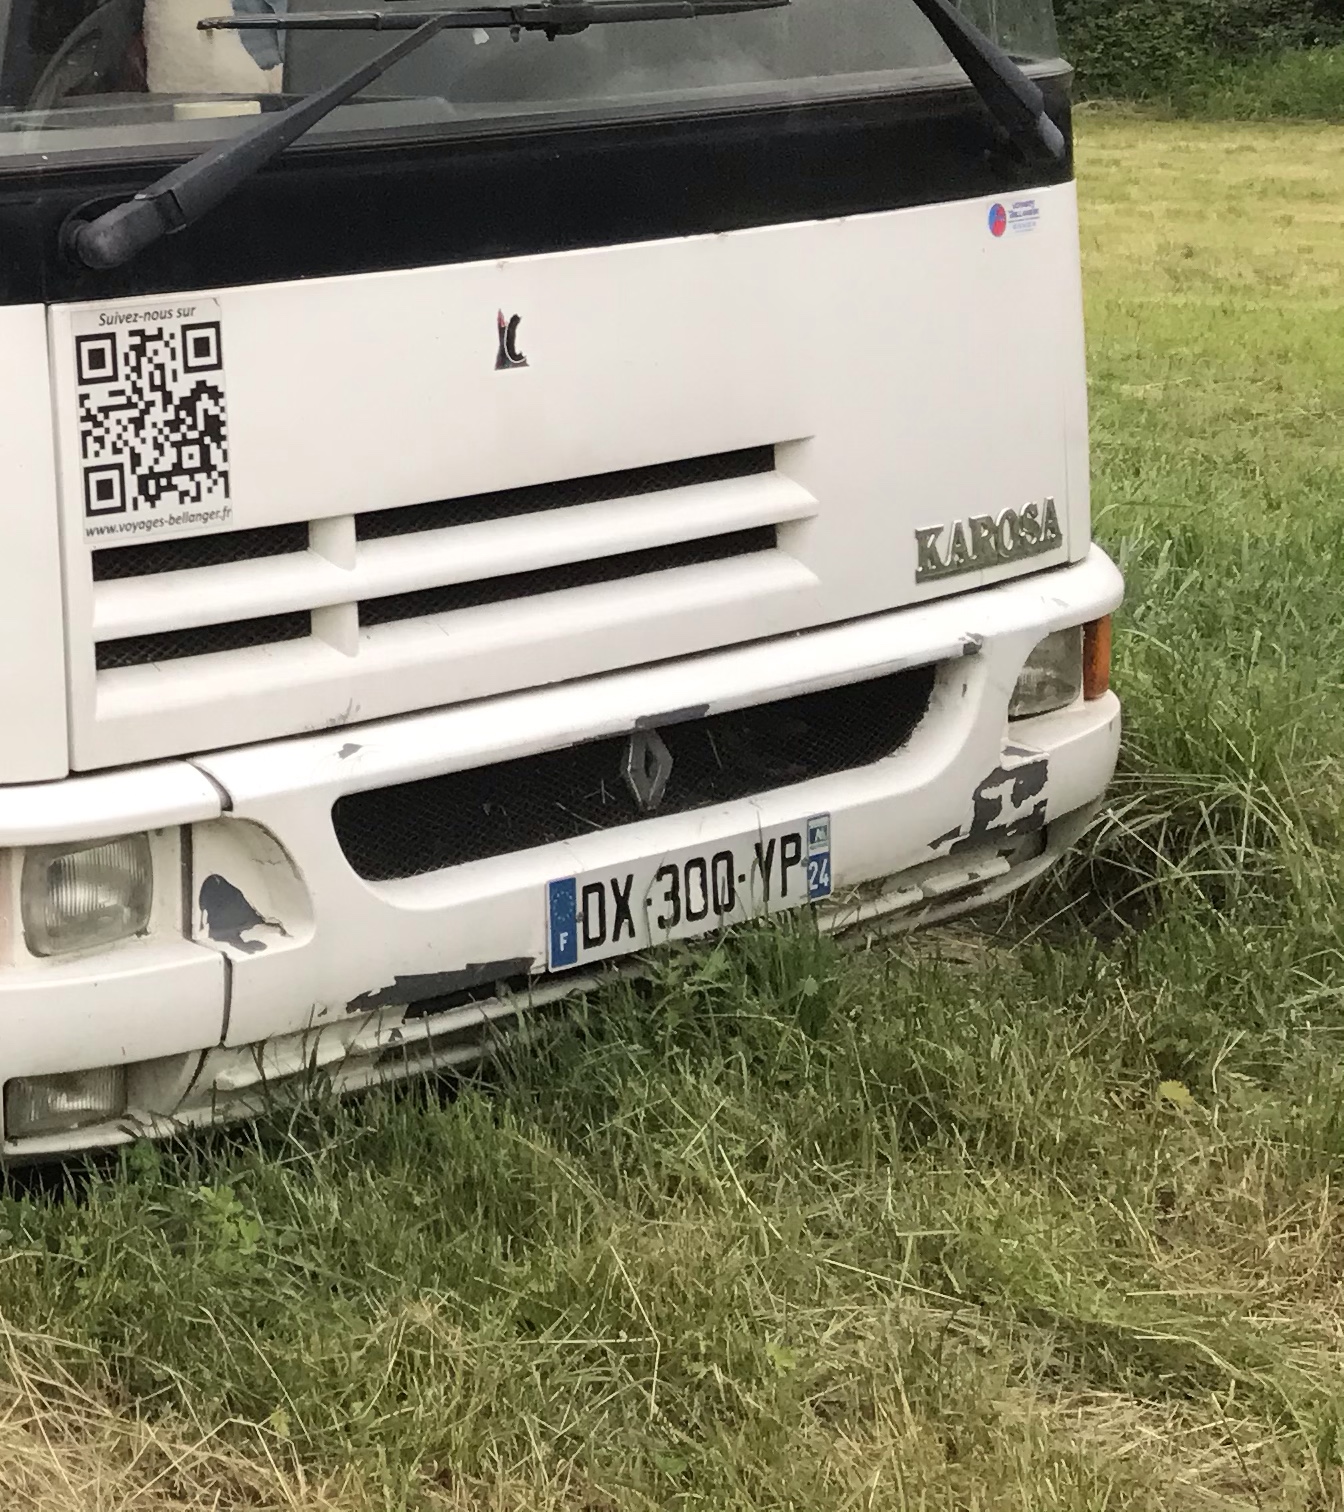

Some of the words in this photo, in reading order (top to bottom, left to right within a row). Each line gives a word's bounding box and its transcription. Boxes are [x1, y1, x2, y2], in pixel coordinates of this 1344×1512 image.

[98, 308, 174, 327] Suivez-nous
[176, 305, 197, 319] sur
[85, 505, 233, 538] www.voyages-bellanger.fr
[914, 496, 1063, 585] KAROSA
[808, 857, 830, 891] 24
[559, 931, 569, 952] F
